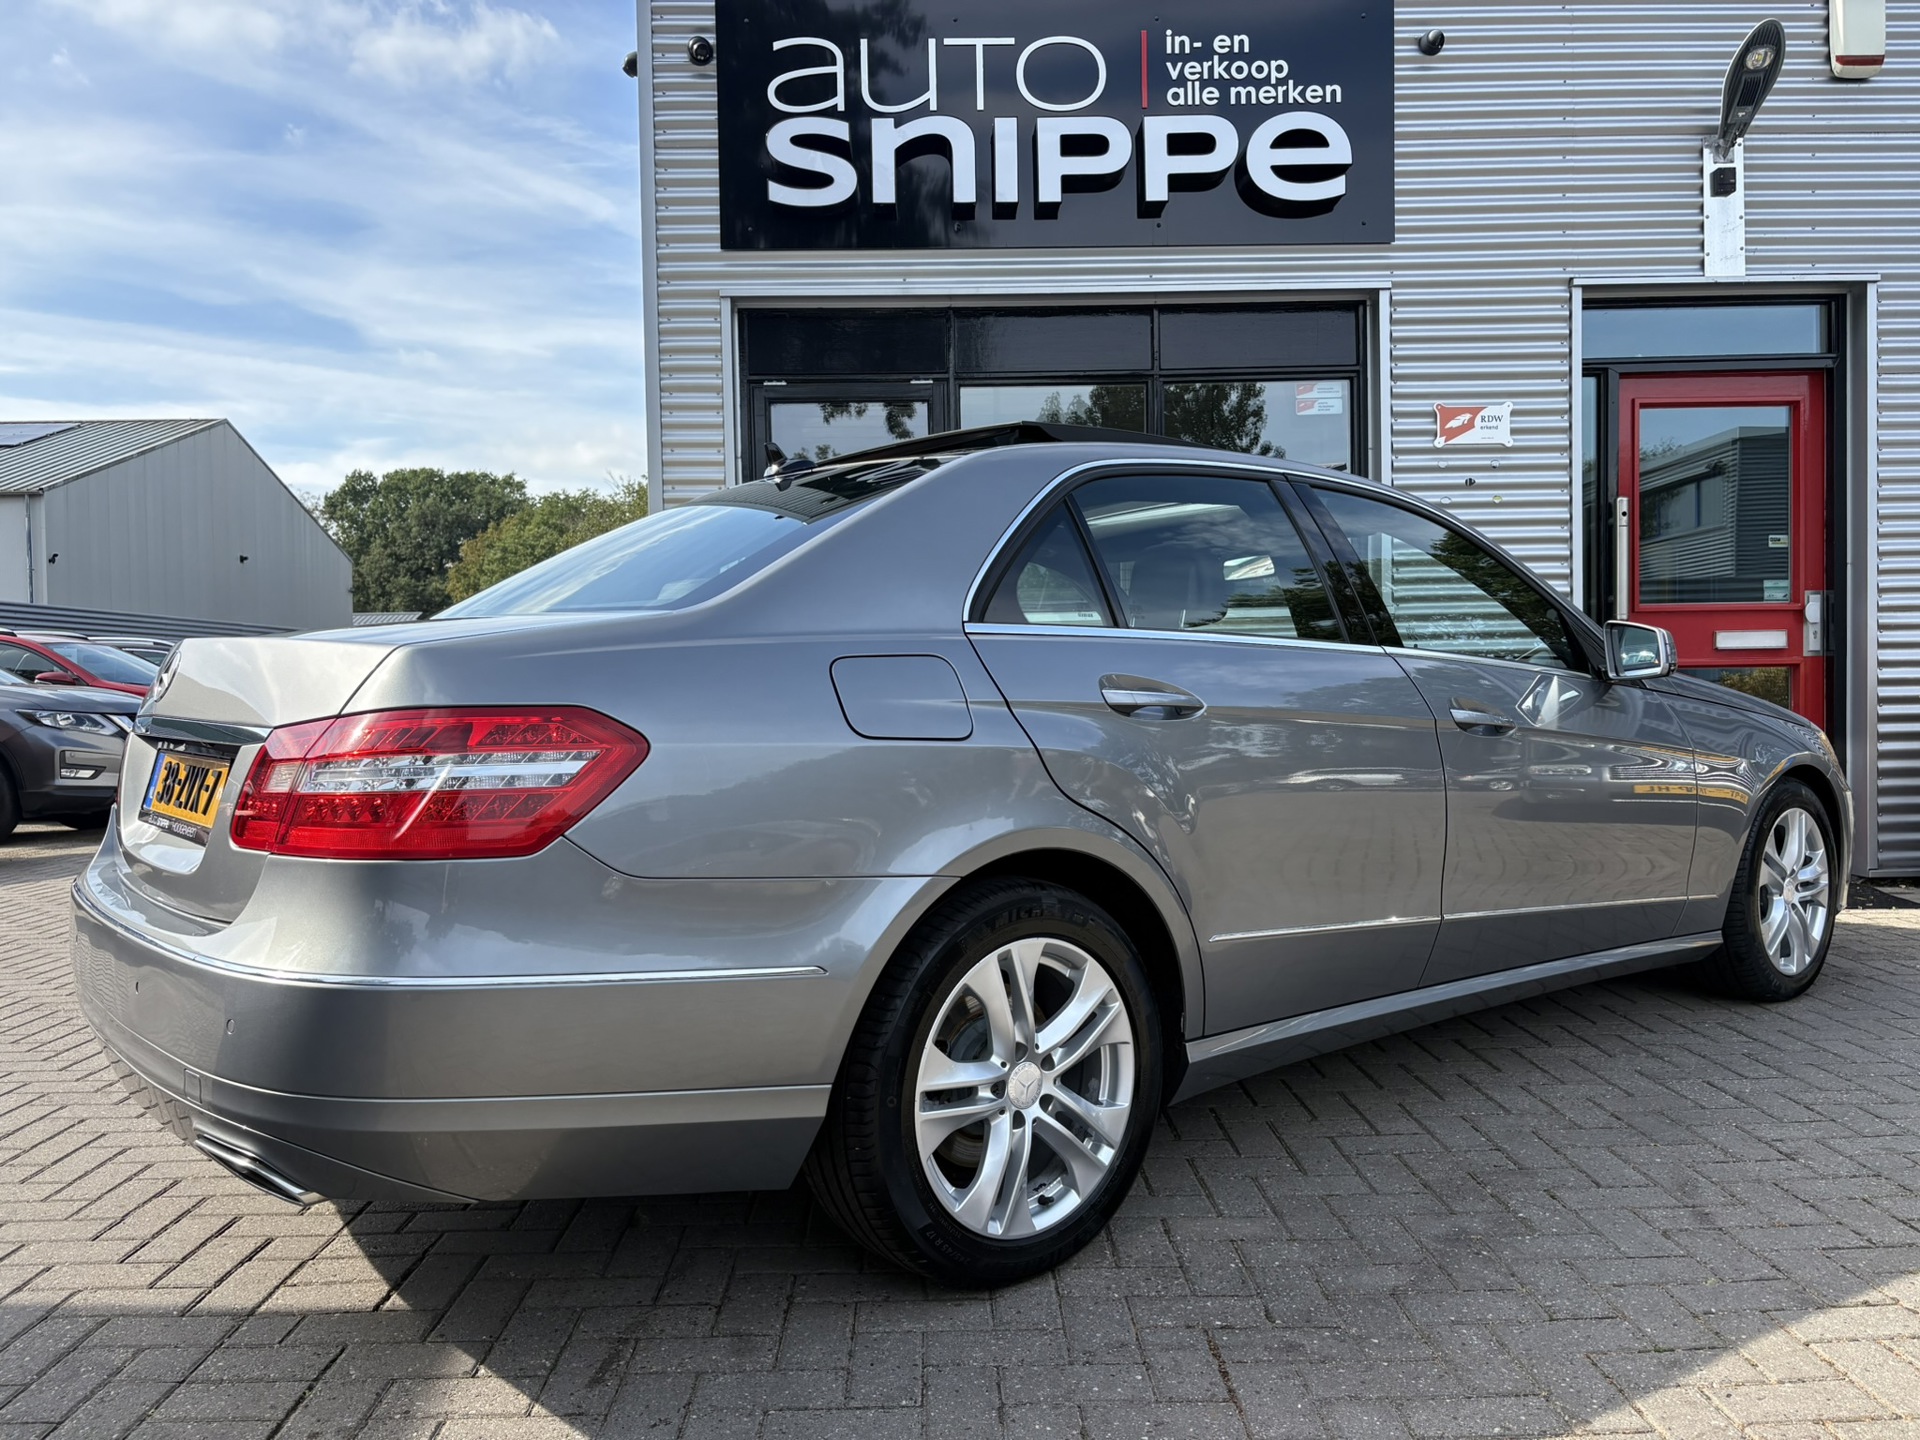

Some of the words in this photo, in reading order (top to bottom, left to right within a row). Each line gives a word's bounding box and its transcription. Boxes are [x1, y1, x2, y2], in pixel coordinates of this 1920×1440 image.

[1165, 30, 1202, 54] in-
[1213, 34, 1250, 54] en
[1165, 54, 1289, 85] verkoop
[1166, 80, 1220, 106] alle
[1230, 79, 1343, 105] merken
[1480, 415, 1504, 423] RDW
